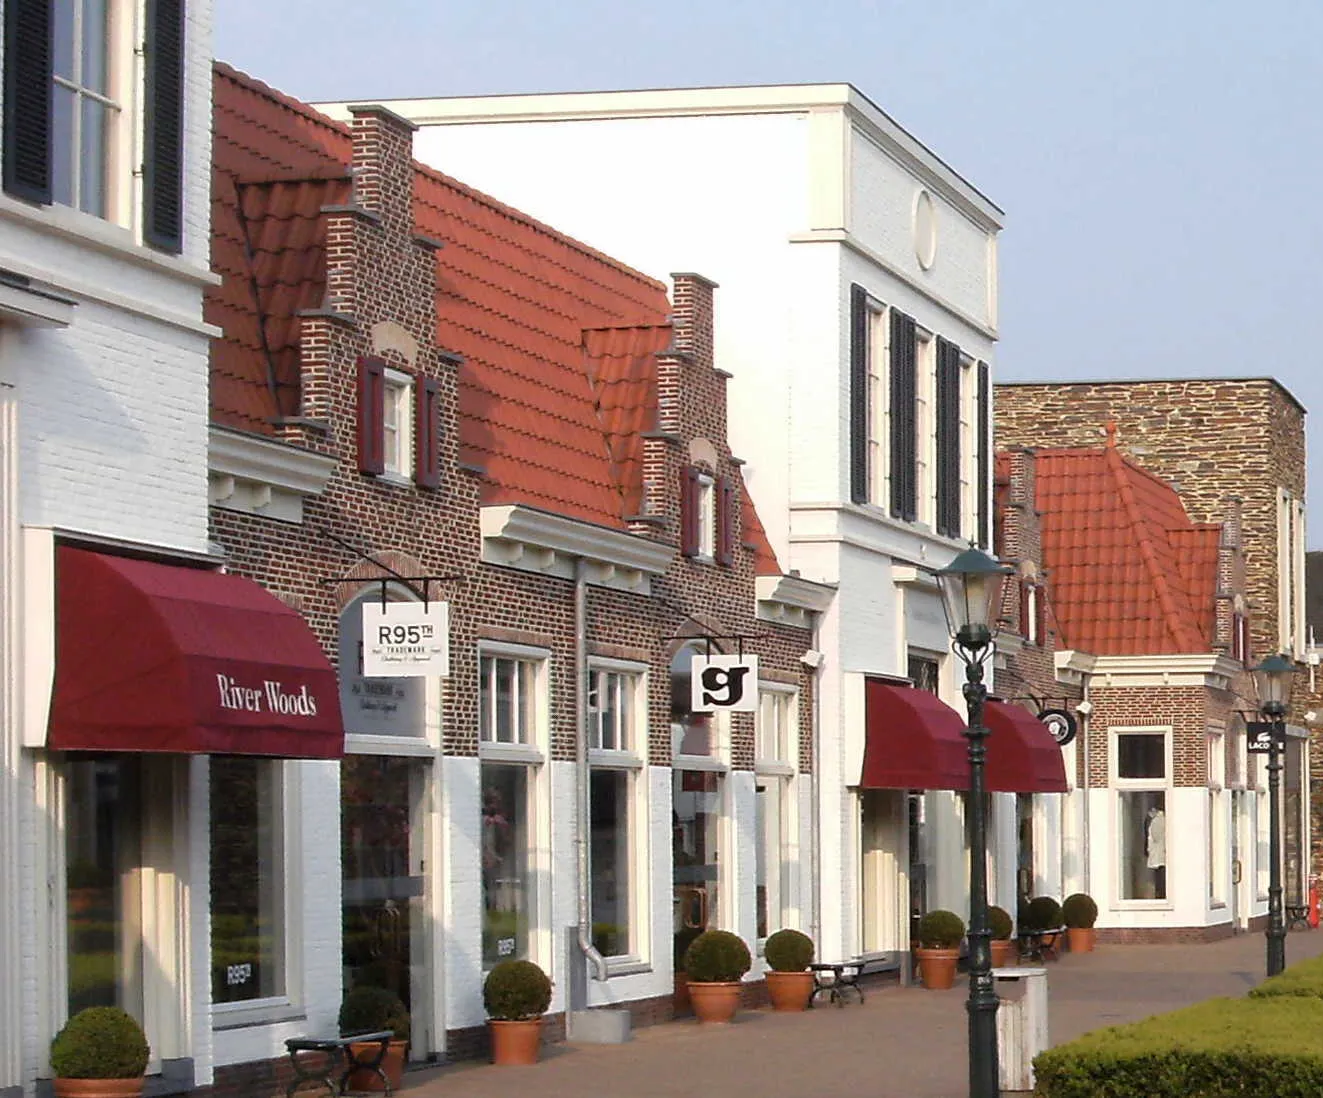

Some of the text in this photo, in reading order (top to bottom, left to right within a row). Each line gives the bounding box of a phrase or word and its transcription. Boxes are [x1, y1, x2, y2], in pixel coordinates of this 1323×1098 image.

[216, 673, 317, 716] River Woods
[1248, 741, 1285, 749] LACOE
